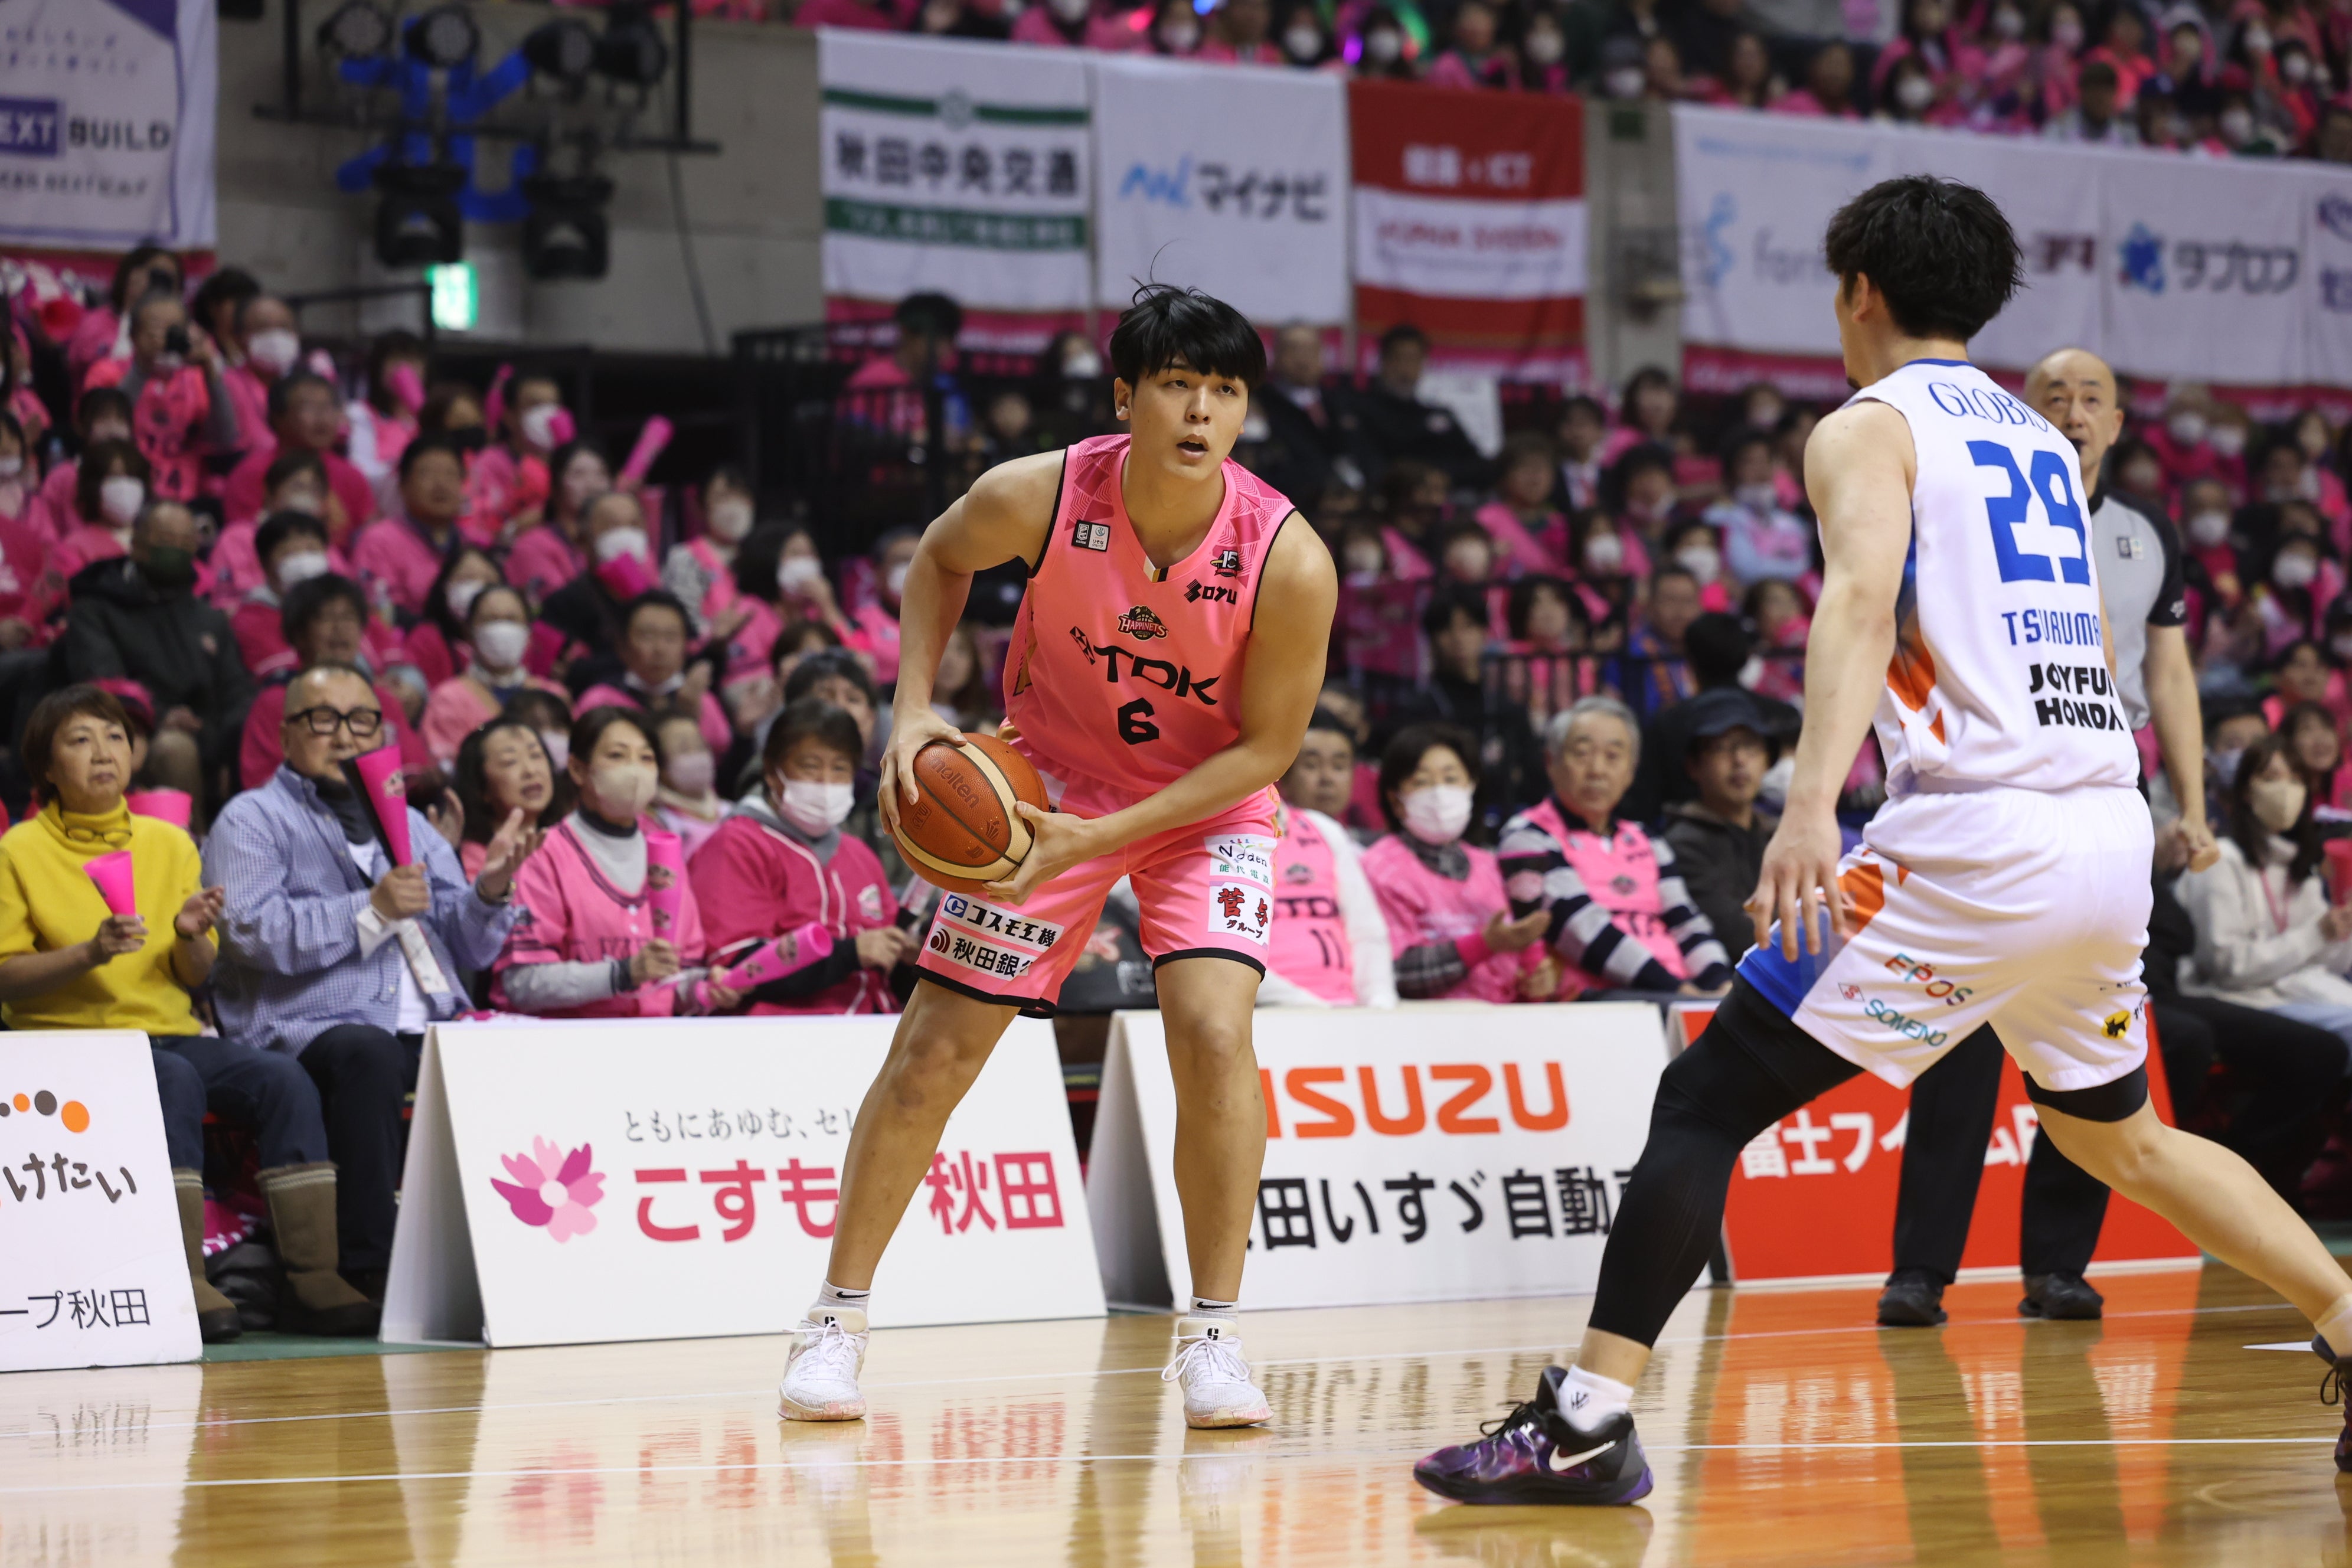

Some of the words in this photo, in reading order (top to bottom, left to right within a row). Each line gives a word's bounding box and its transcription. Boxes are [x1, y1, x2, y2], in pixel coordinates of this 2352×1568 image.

[68, 117, 170, 149] BUILD
[837, 130, 1077, 197] 秋田中央交通
[1199, 162, 1326, 222] マイナビ
[1928, 383, 2048, 432] GLOBIS
[1966, 440, 2090, 586] 29
[1222, 550, 1238, 569] 15
[1119, 616, 1167, 636] HAPPINETS
[1093, 645, 1221, 705] TDK
[1118, 697, 1159, 745] 6
[2035, 697, 2125, 731] HONDA
[932, 757, 979, 809] molten
[1884, 953, 1973, 1007] EPOS
[1864, 999, 1947, 1047] SOMENO
[1260, 1061, 1570, 1139] ISUZU
[634, 1150, 1064, 1243] こすも秋田
